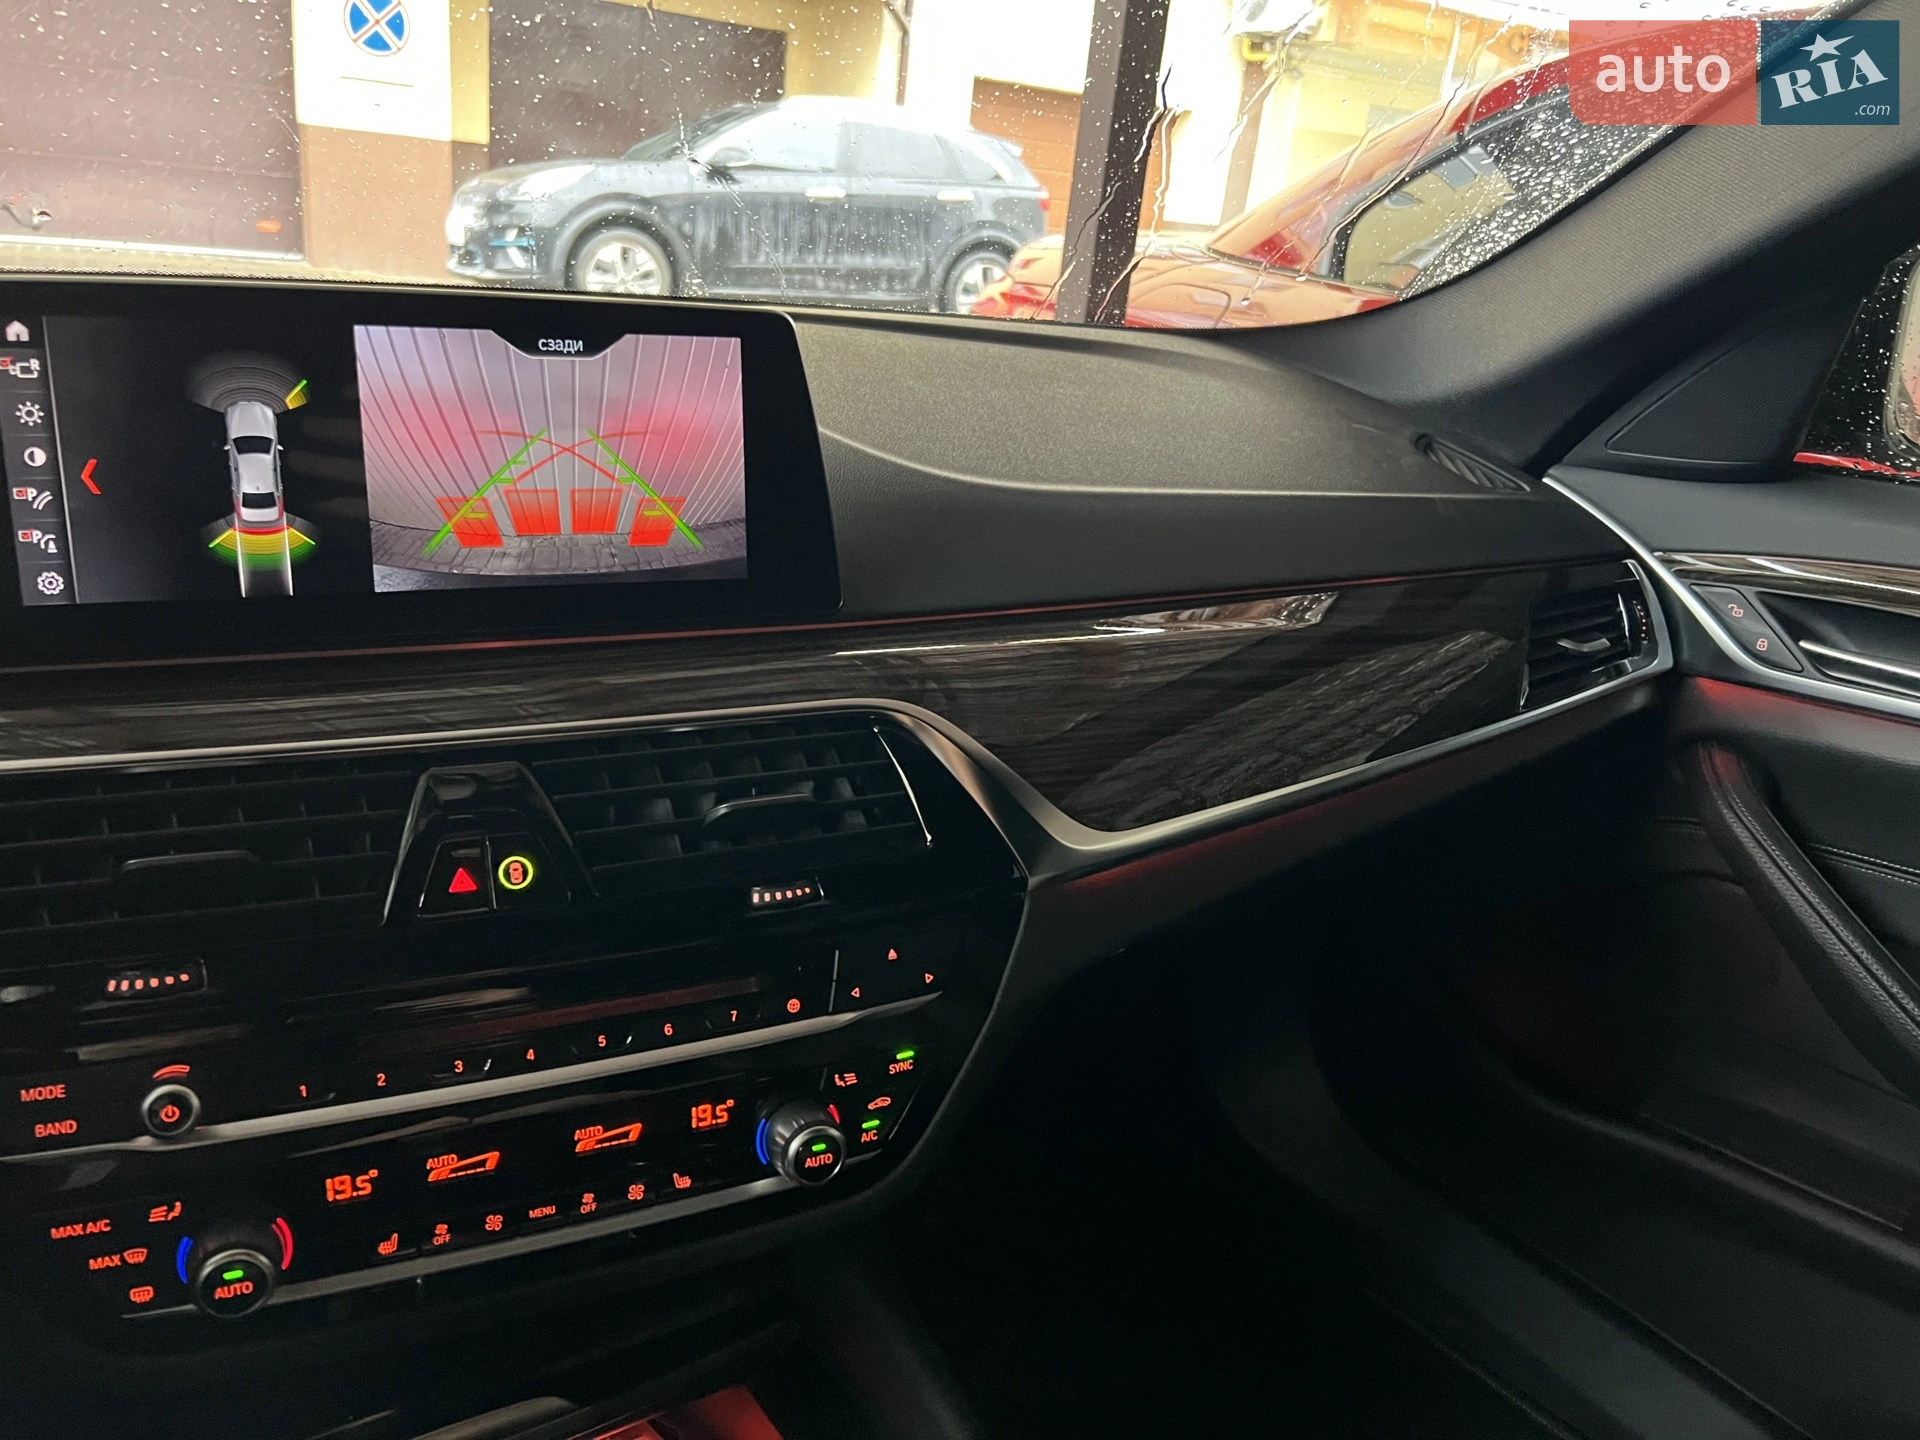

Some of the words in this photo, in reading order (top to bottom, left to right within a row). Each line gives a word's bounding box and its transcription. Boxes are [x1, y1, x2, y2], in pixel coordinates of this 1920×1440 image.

[538, 338, 583, 354] сзади
[730, 1010, 738, 1022] 7
[663, 1023, 673, 1036] 6
[597, 1034, 607, 1047] 5
[526, 1048, 535, 1061] 4
[454, 1060, 464, 1073] 3
[888, 1060, 914, 1075] SYNC
[376, 1072, 387, 1087] 2
[20, 1083, 66, 1102] MODE
[299, 1084, 307, 1098] 1
[34, 1119, 78, 1138] BAND
[573, 1125, 604, 1142] AUTO
[860, 1129, 878, 1143] A/C
[425, 1153, 458, 1170] AUTO
[804, 1152, 834, 1169] AUTO
[528, 1205, 556, 1219] MENU
[580, 1202, 597, 1214] OFF
[50, 1224, 84, 1239] MAX
[85, 1218, 112, 1235] A/C
[432, 1233, 451, 1246] OFF
[88, 1255, 122, 1270] MAX
[214, 1281, 254, 1300] AUTO
